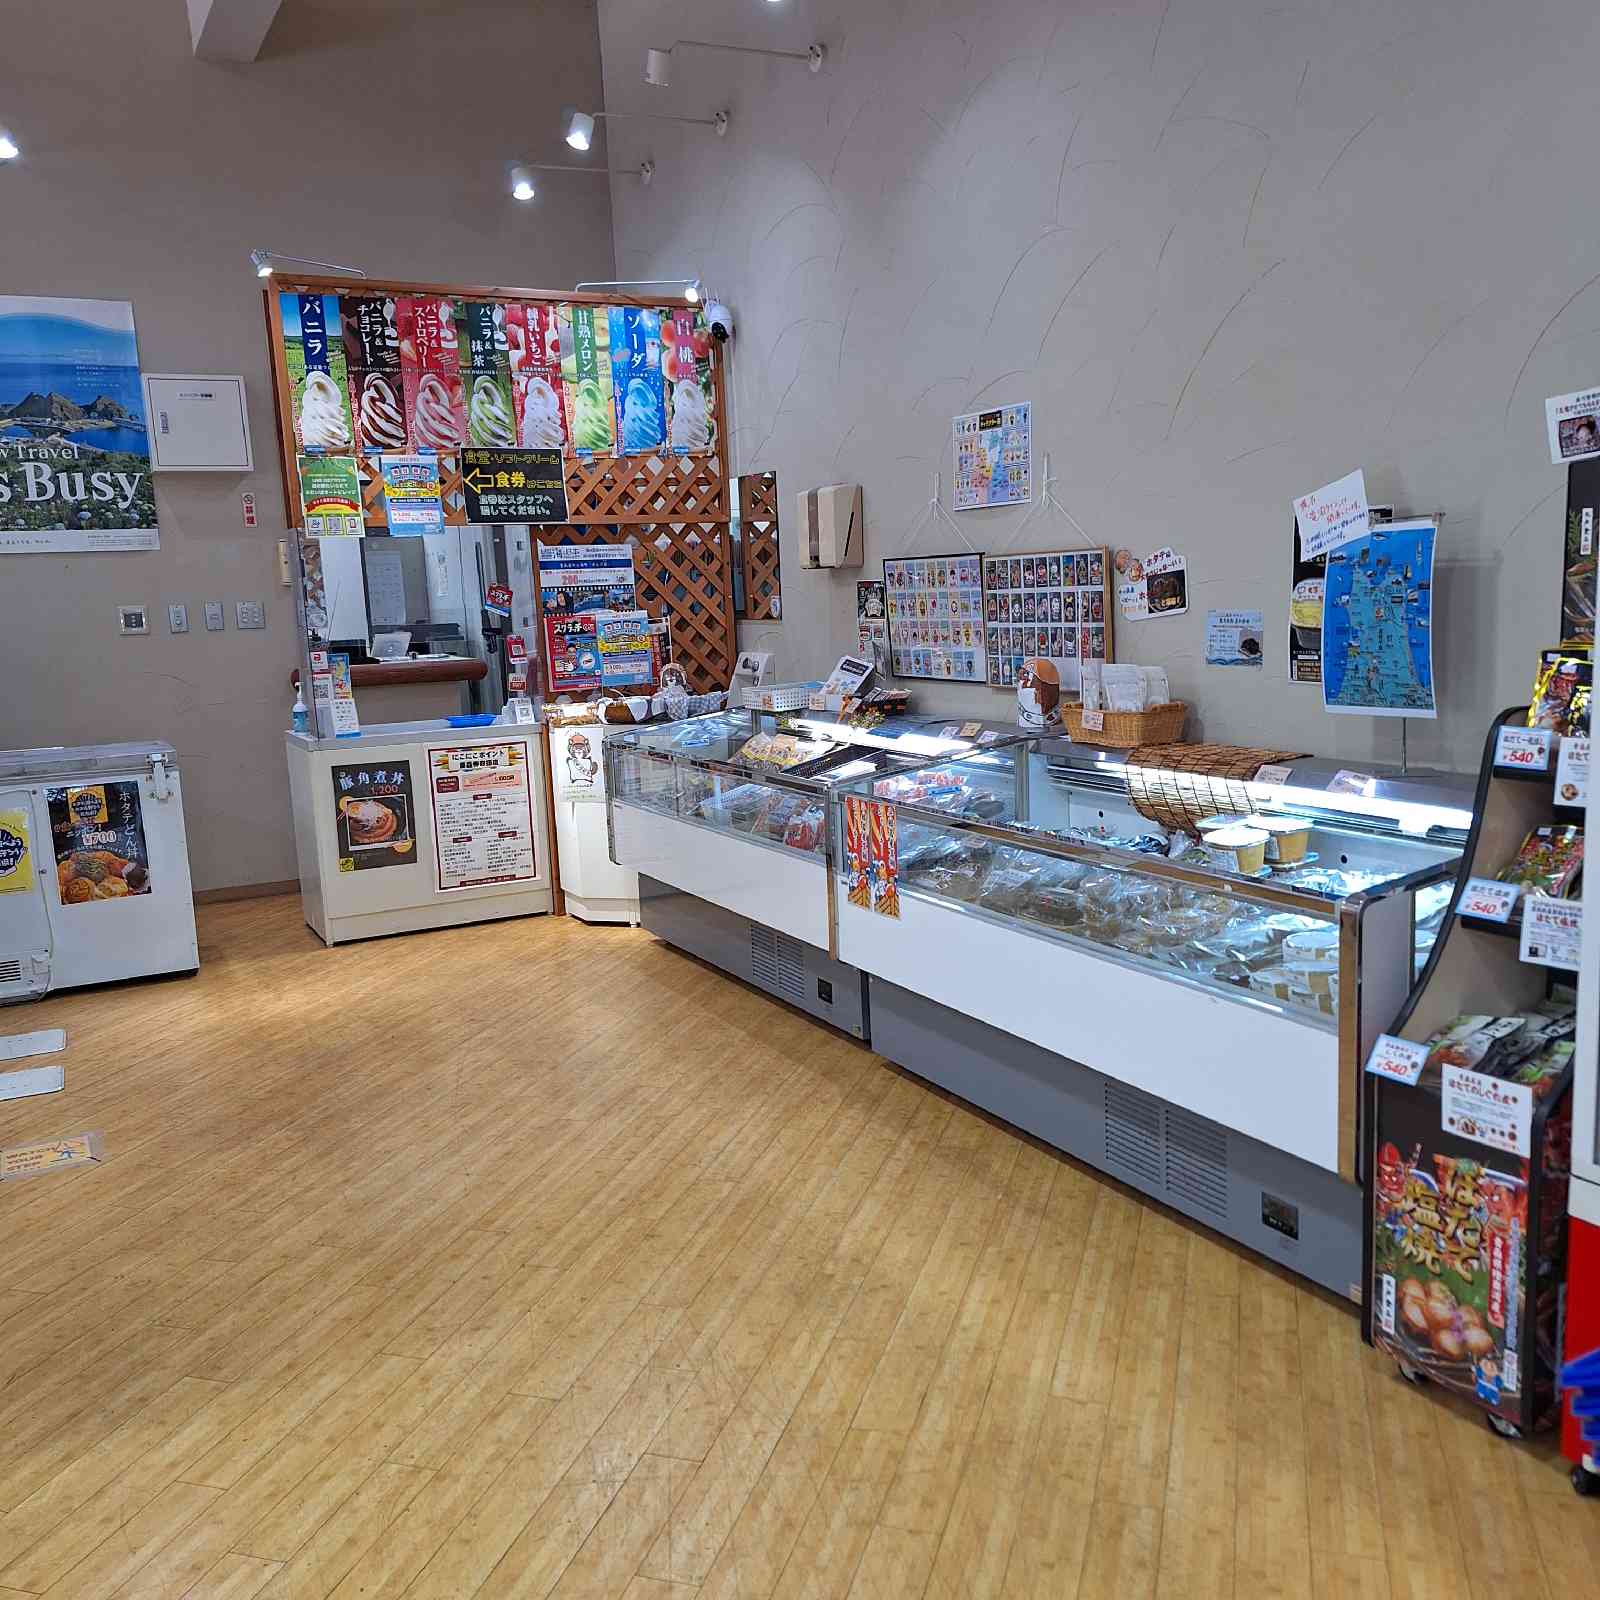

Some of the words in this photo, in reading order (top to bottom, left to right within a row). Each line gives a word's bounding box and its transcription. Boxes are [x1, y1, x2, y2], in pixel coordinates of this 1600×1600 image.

[302, 300, 323, 356] バニラ
[358, 304, 374, 366] チョコレート
[369, 301, 384, 346] バニラ&
[415, 306, 428, 368] ストロベリー
[480, 306, 494, 350] バニラ&
[627, 315, 646, 369] ソーダ
[676, 318, 694, 364] 白桃
[471, 339, 486, 368] 抹茶
[14, 444, 80, 460] Travel
[20, 461, 145, 509] Busy
[451, 750, 505, 761] にこにこポイント
